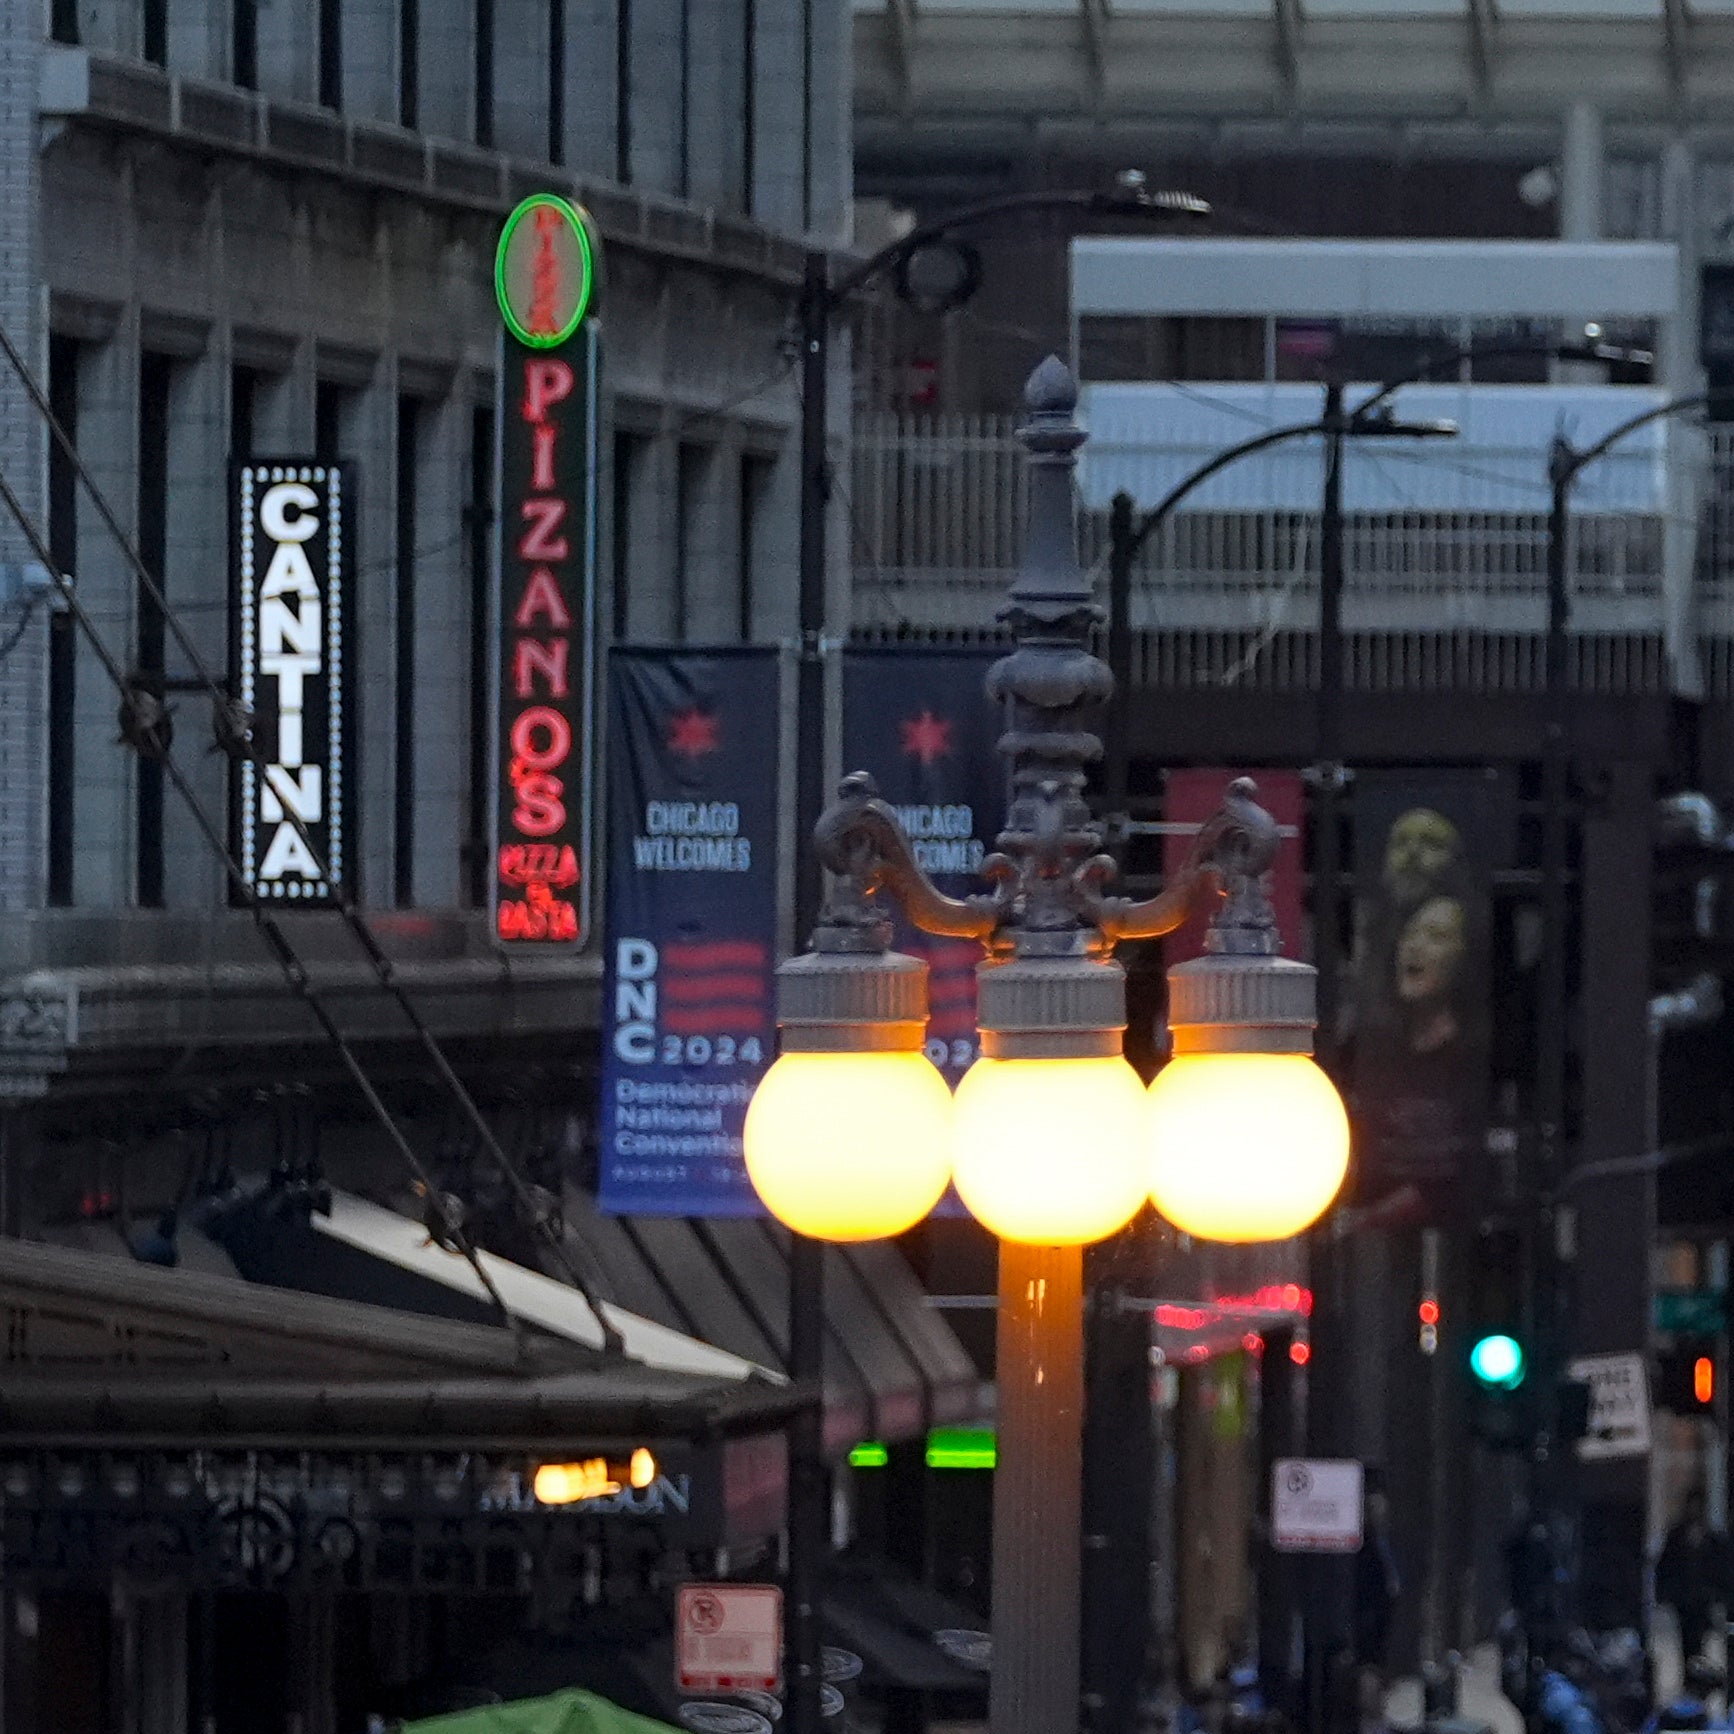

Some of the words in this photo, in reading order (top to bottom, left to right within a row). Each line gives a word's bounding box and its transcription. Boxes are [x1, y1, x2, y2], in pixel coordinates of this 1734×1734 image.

[259, 483, 322, 880] CANTINA
[646, 800, 740, 836] CHICAGO
[897, 804, 972, 838] HICAGO
[633, 837, 752, 871] WELCOMES
[613, 937, 659, 1064] DNC
[661, 1035, 764, 1065] 2024
[615, 1105, 723, 1130] National
